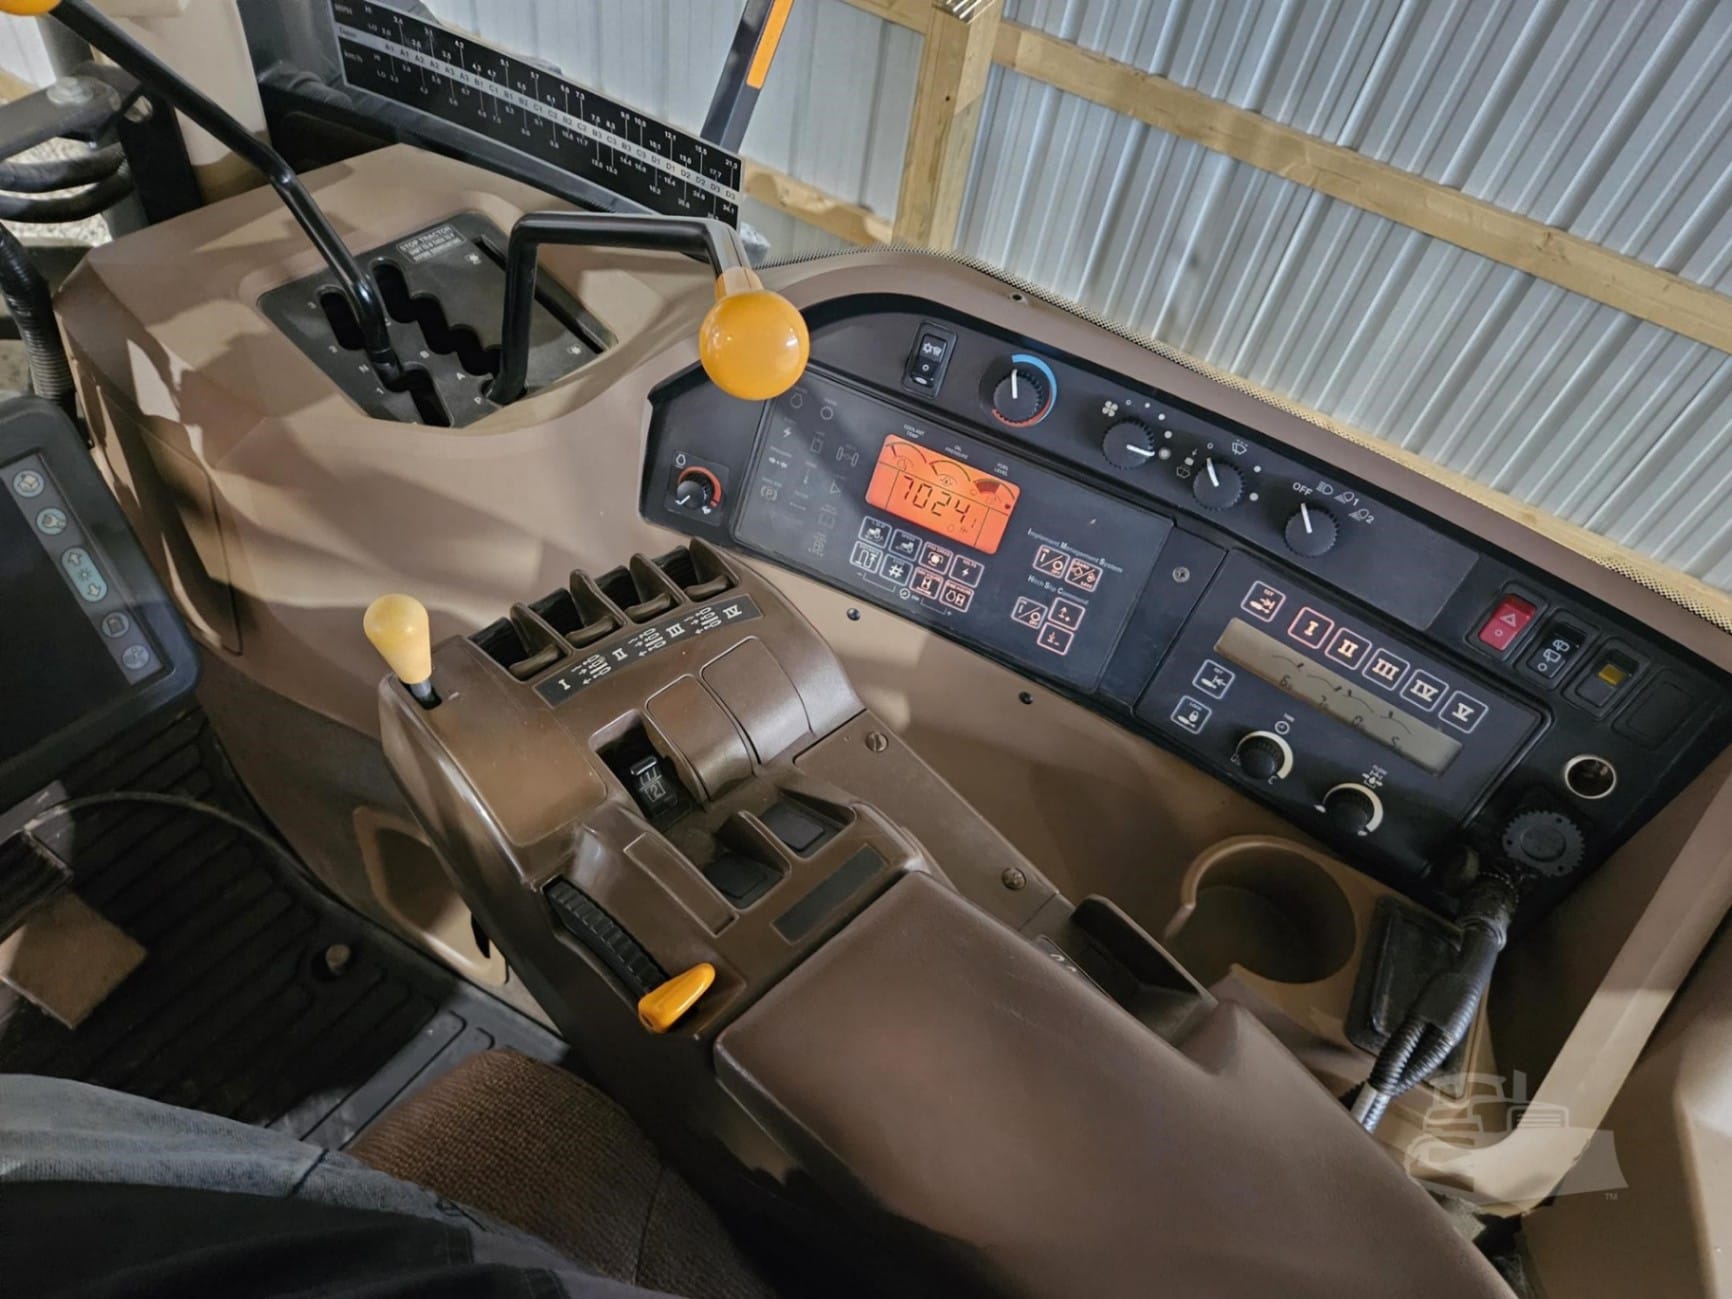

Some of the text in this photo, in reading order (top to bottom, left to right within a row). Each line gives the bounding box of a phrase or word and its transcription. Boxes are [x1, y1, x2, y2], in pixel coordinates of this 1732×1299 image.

[1292, 481, 1313, 496] OFF
[904, 475, 970, 524] 7024
[1353, 498, 1359, 506] 1
[1365, 515, 1375, 524] 2
[723, 605, 742, 619] IV
[666, 623, 685, 638] III
[612, 648, 628, 661] II
[1337, 639, 1359, 658] II
[1371, 658, 1400, 681] III
[1410, 679, 1439, 702] IV
[1451, 702, 1474, 722] V
